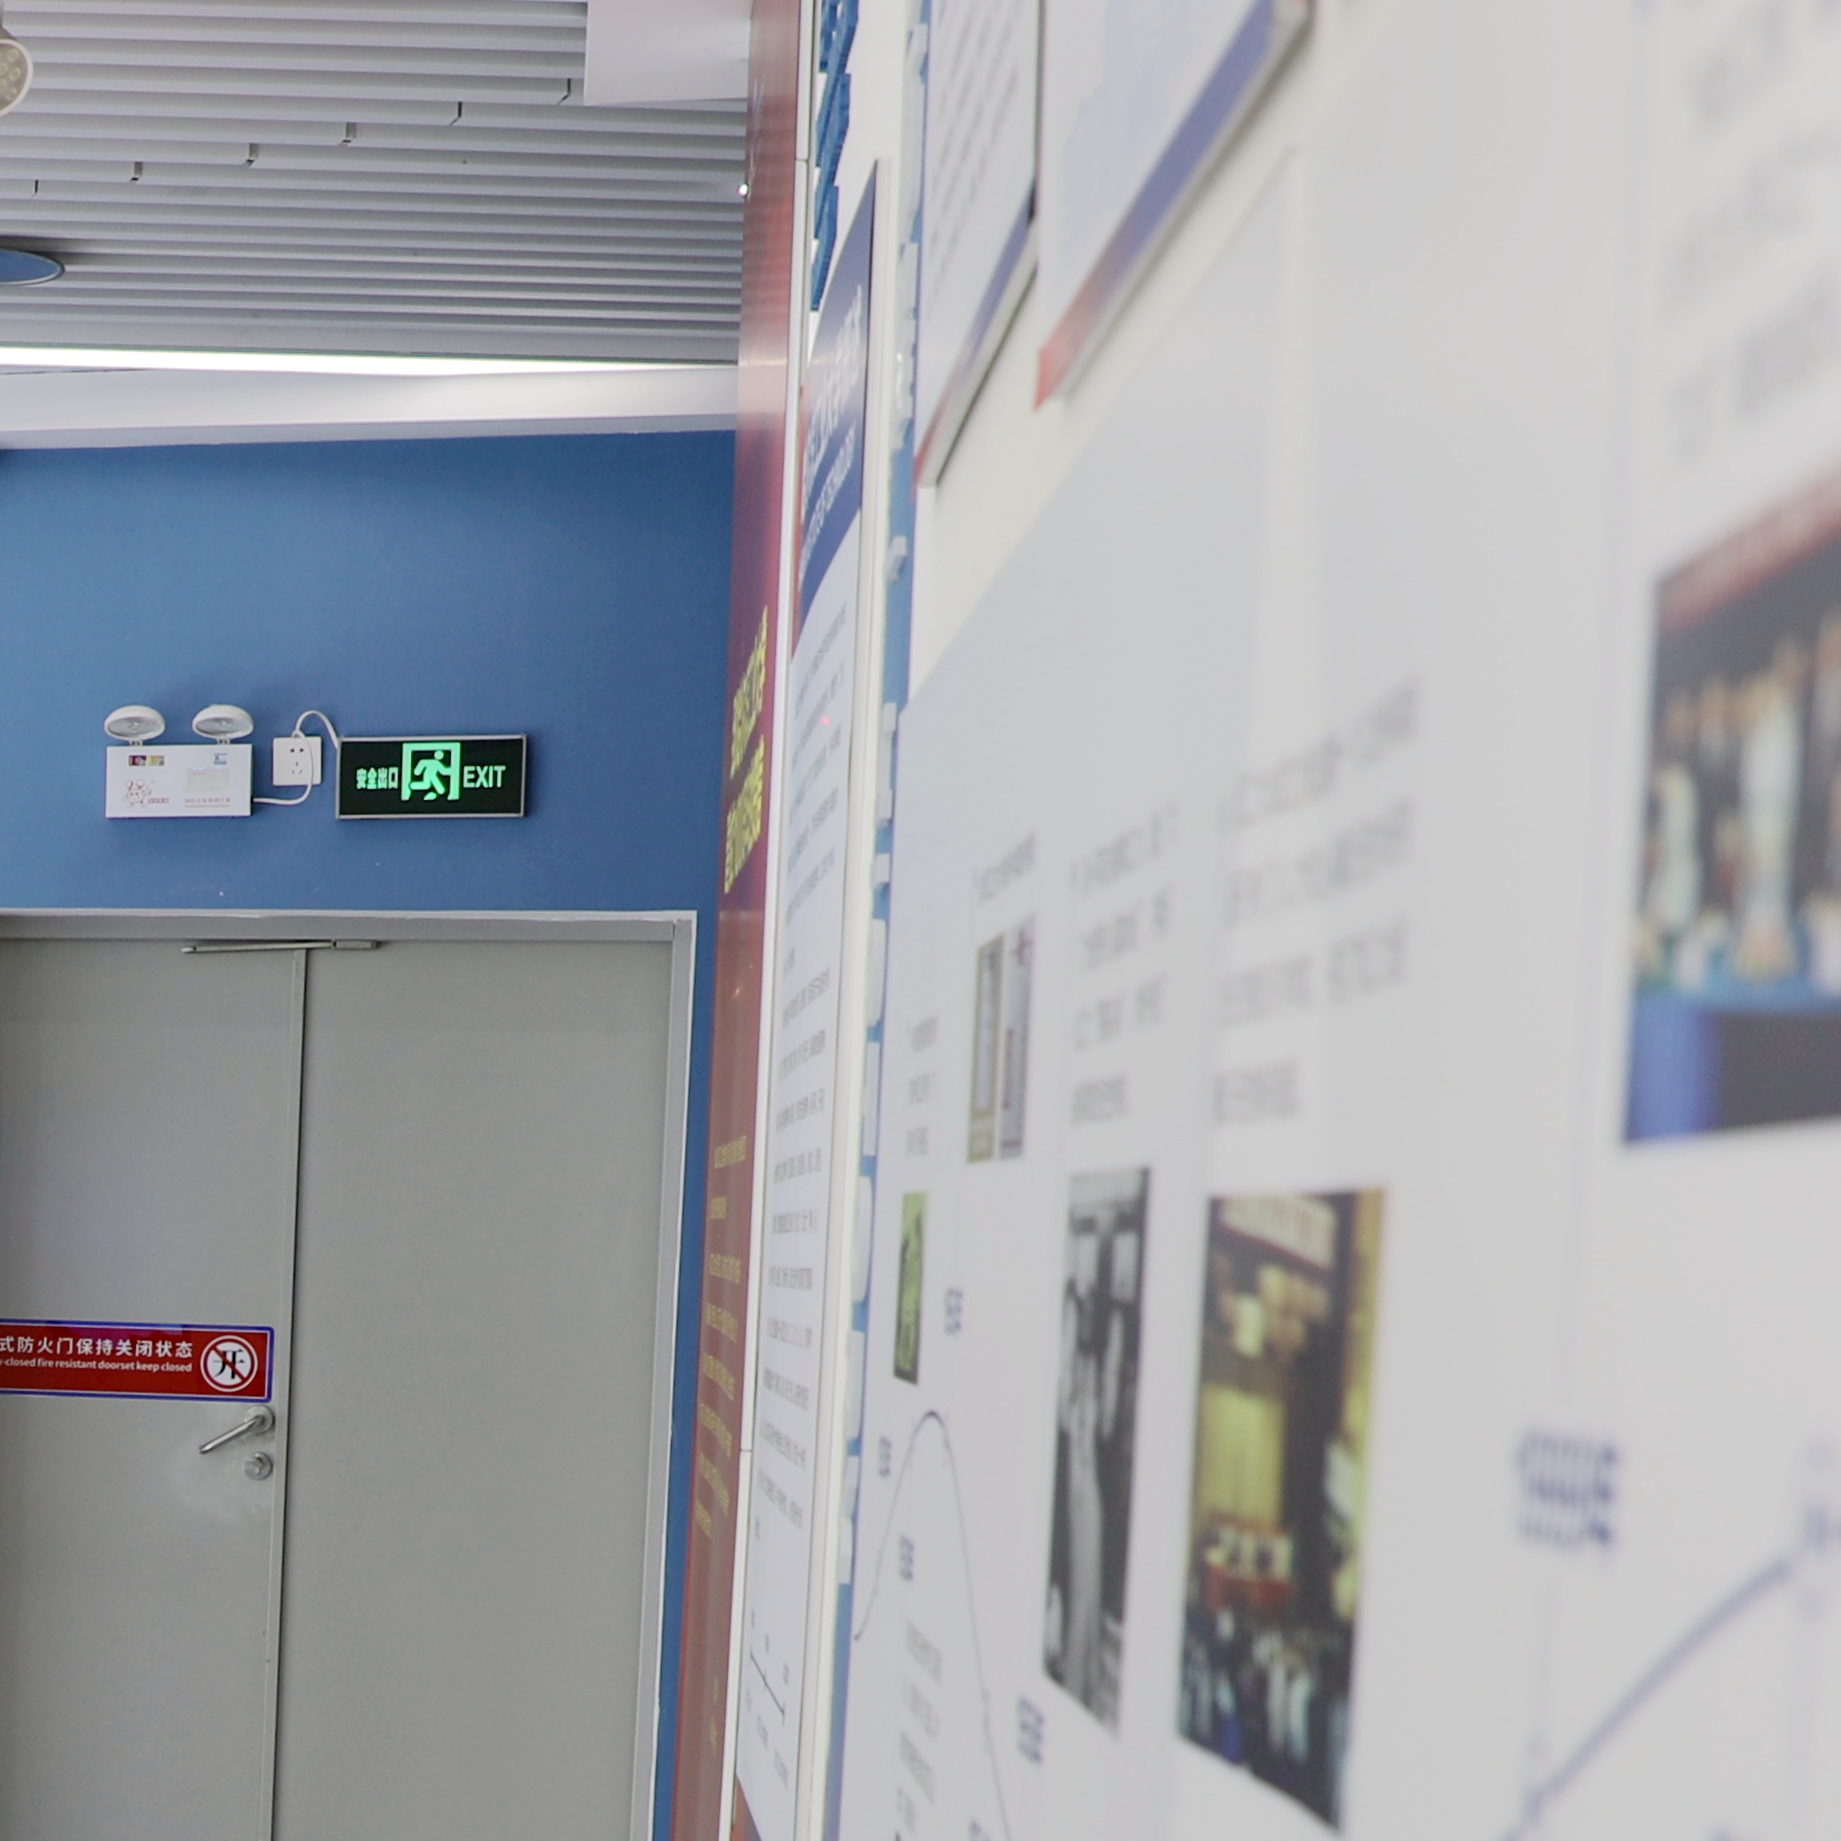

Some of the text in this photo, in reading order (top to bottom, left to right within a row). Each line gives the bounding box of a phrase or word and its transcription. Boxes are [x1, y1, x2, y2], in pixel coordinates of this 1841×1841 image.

[356, 767, 399, 789] 安全出口
[463, 765, 507, 788] EXIT
[37, 1357, 54, 1367] fire
[54, 1358, 98, 1370] resistant
[98, 1360, 135, 1371] doorset
[136, 1361, 160, 1373] keep
[161, 1362, 193, 1373] closed
